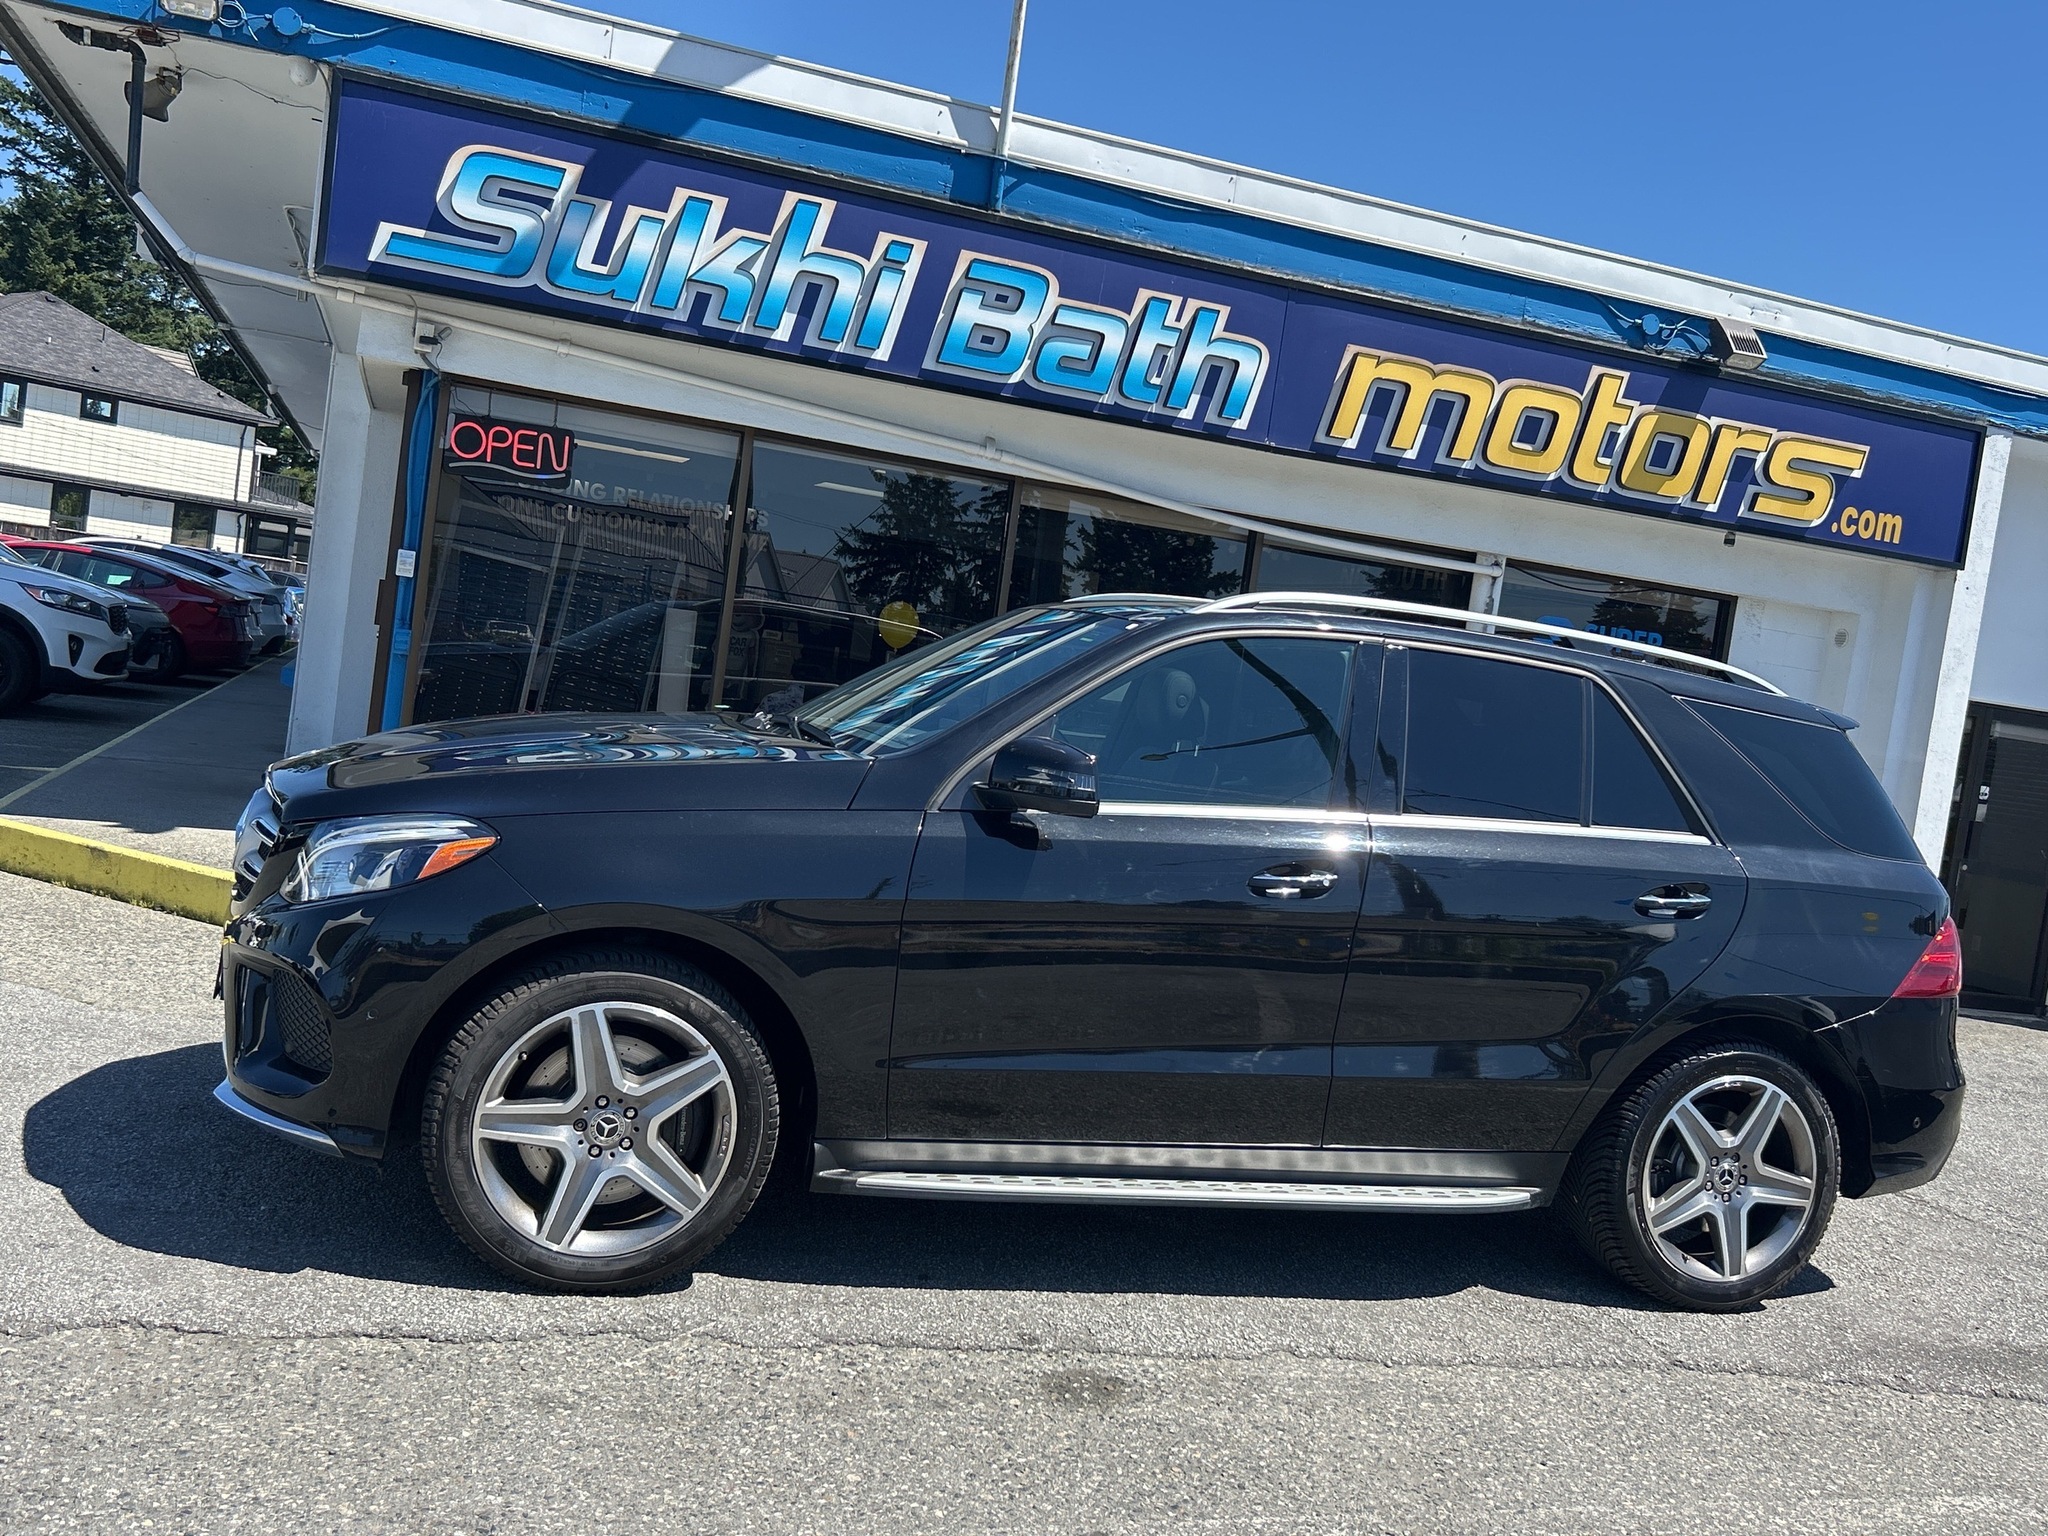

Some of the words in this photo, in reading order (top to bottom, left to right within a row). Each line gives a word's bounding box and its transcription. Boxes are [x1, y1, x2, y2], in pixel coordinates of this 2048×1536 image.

[368, 144, 928, 361] Sukhi
[922, 249, 1270, 430] Bath
[1315, 344, 1870, 527] motors
[1830, 505, 1903, 545] .com
[450, 421, 570, 472] OPEN
[552, 503, 667, 537] CUSTOMER
[613, 486, 769, 528] RELATIONSPS
[730, 636, 747, 647] CAR
